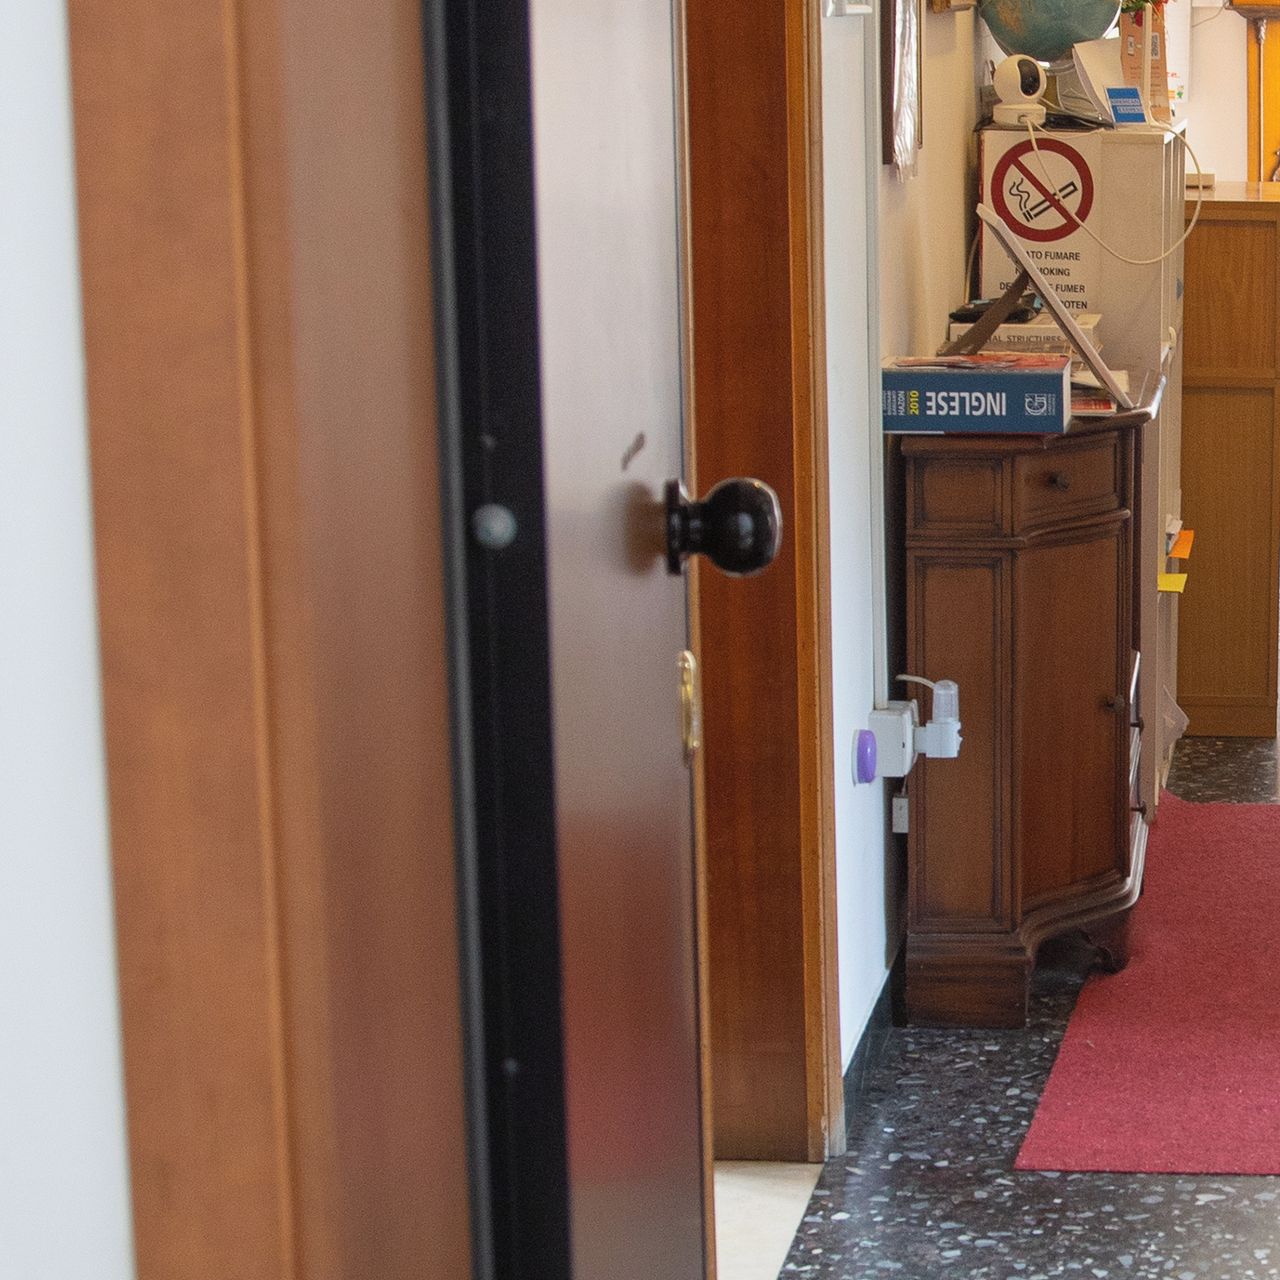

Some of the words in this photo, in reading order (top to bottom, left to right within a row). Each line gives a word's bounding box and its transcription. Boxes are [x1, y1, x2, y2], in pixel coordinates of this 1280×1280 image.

[1045, 251, 1081, 261] FUMARE
[1055, 284, 1086, 293] FUMER
[909, 390, 919, 415] 2010
[925, 391, 1006, 416] INGLESE
